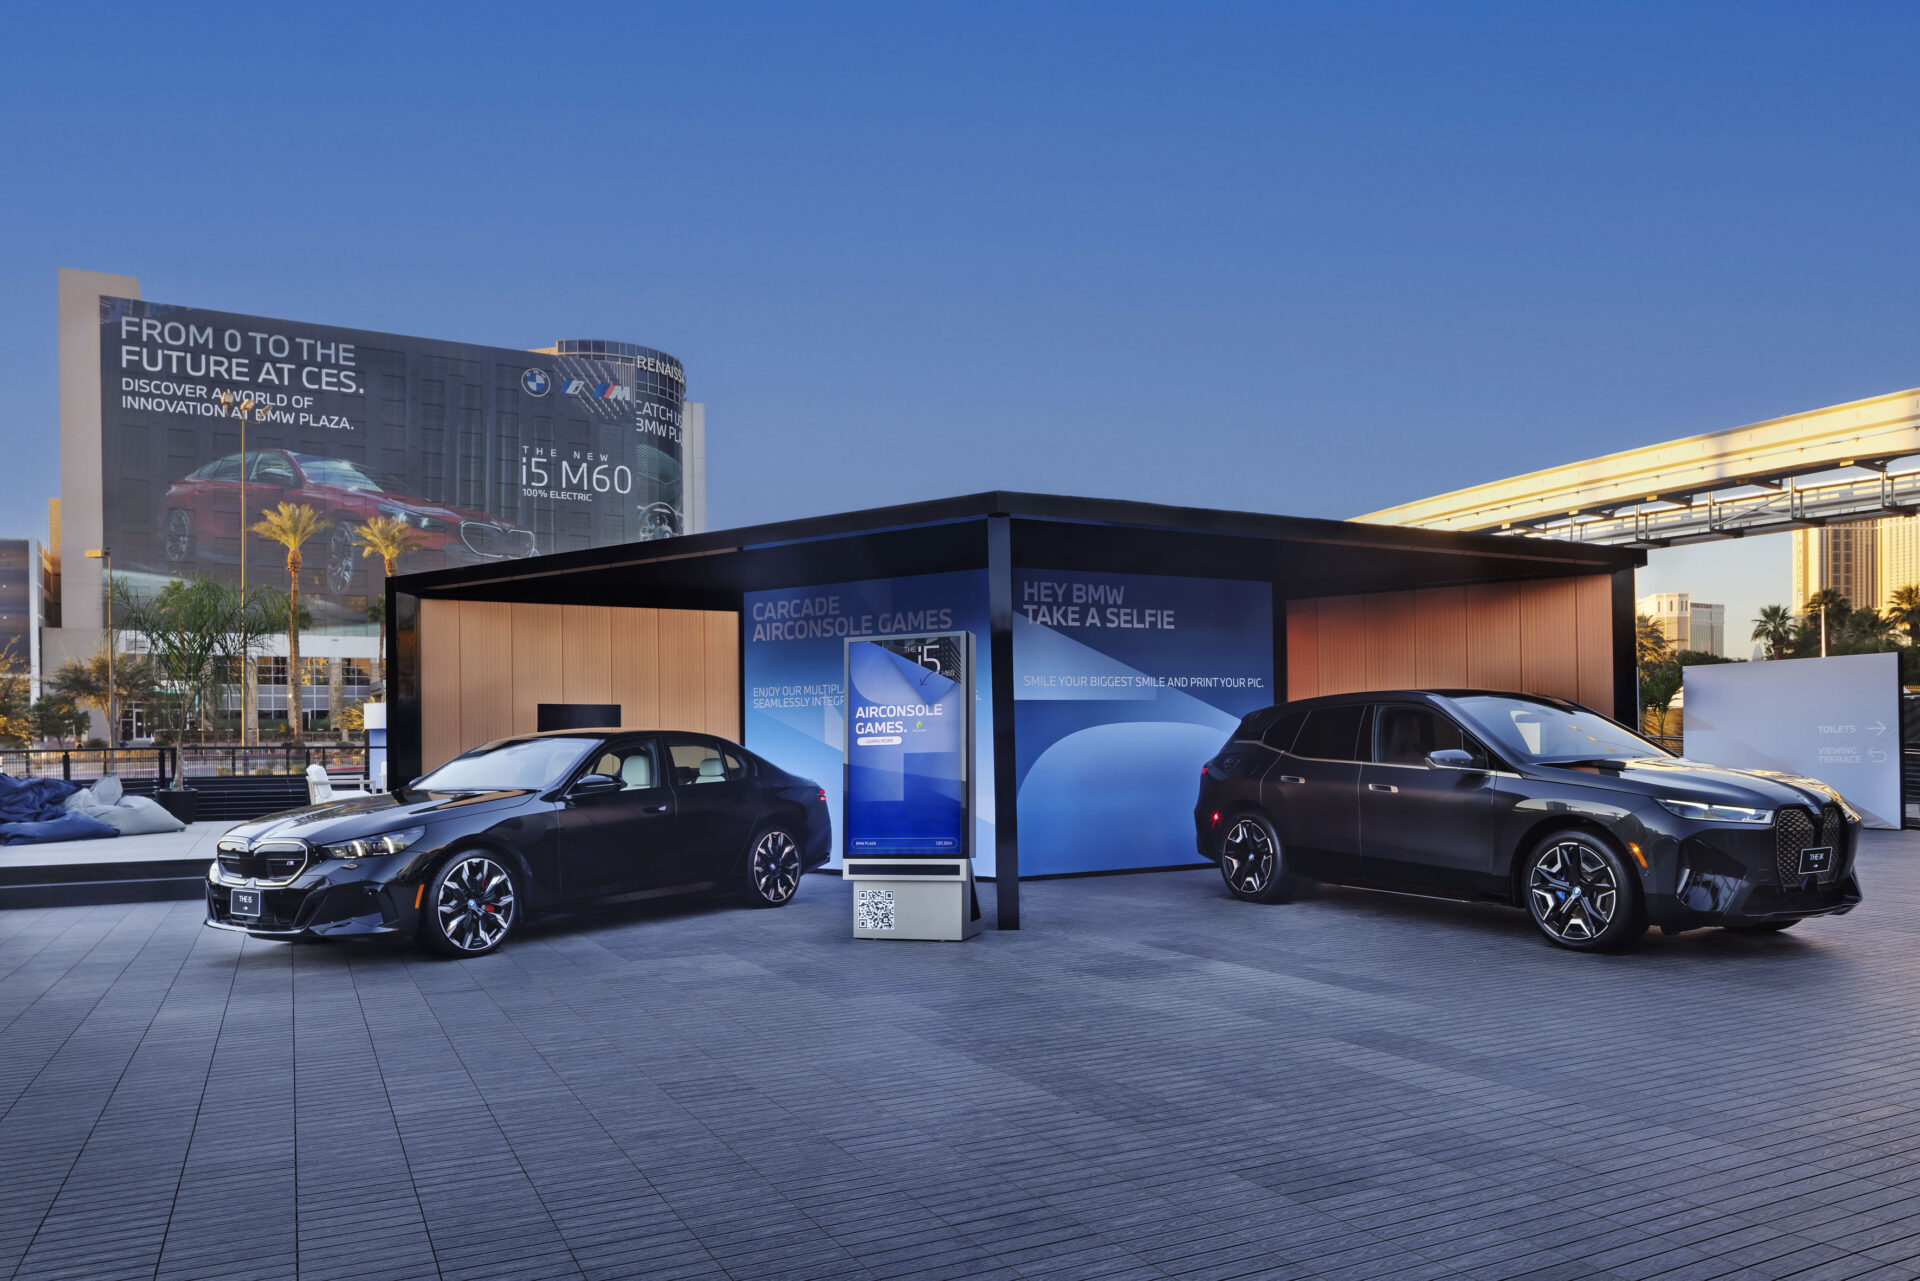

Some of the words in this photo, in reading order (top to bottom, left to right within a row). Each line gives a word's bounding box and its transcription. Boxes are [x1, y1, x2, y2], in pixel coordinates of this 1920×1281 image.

[121, 316, 214, 349] FROM
[224, 329, 241, 352] 0
[248, 332, 290, 358] TO
[295, 337, 356, 366] THE
[121, 345, 250, 382] FUTURE
[257, 362, 296, 386] AT
[302, 367, 364, 394] CES.
[122, 378, 207, 399] DISCOVER
[211, 387, 224, 400] A
[226, 388, 288, 407] WORLD
[291, 396, 313, 409] OF
[122, 396, 226, 418] INNOVATION
[255, 409, 295, 424] BMW
[299, 413, 354, 430] PLAZA.
[522, 445, 557, 456] THE
[573, 451, 609, 462] NEW
[522, 457, 548, 487] i5
[562, 460, 632, 494] M60
[522, 488, 548, 498] 100%
[550, 491, 592, 502] ELECTRIC
[1023, 581, 1068, 603] HEY
[1072, 583, 1125, 605] BMW
[753, 596, 840, 621] CARCADE
[1023, 604, 1081, 627] TAKE
[1085, 607, 1101, 627] A
[1106, 608, 1175, 630] SELFIE
[752, 615, 874, 642] AIRCONSOLE
[878, 608, 952, 633] GAMES
[903, 646, 917, 654] THE
[917, 644, 941, 674] i5
[753, 686, 781, 698] ENJOY
[782, 685, 802, 697] OUR
[1024, 675, 1056, 687] SMILE
[1058, 675, 1088, 687] YOUR
[1090, 676, 1133, 687] BIGGEST
[1135, 676, 1165, 688] SMILE
[1167, 676, 1188, 688] AND
[1190, 677, 1218, 688] PRINT
[1220, 677, 1246, 688] YOUR
[1247, 677, 1264, 688] PIC.
[753, 697, 811, 709] SEAMLESSLY
[855, 703, 943, 719] AIRCONSOLE
[855, 721, 908, 735] GAMES.
[1817, 725, 1857, 734] TOILETS
[1817, 746, 1857, 755] VIEWING
[1817, 755, 1862, 764] TERRACE
